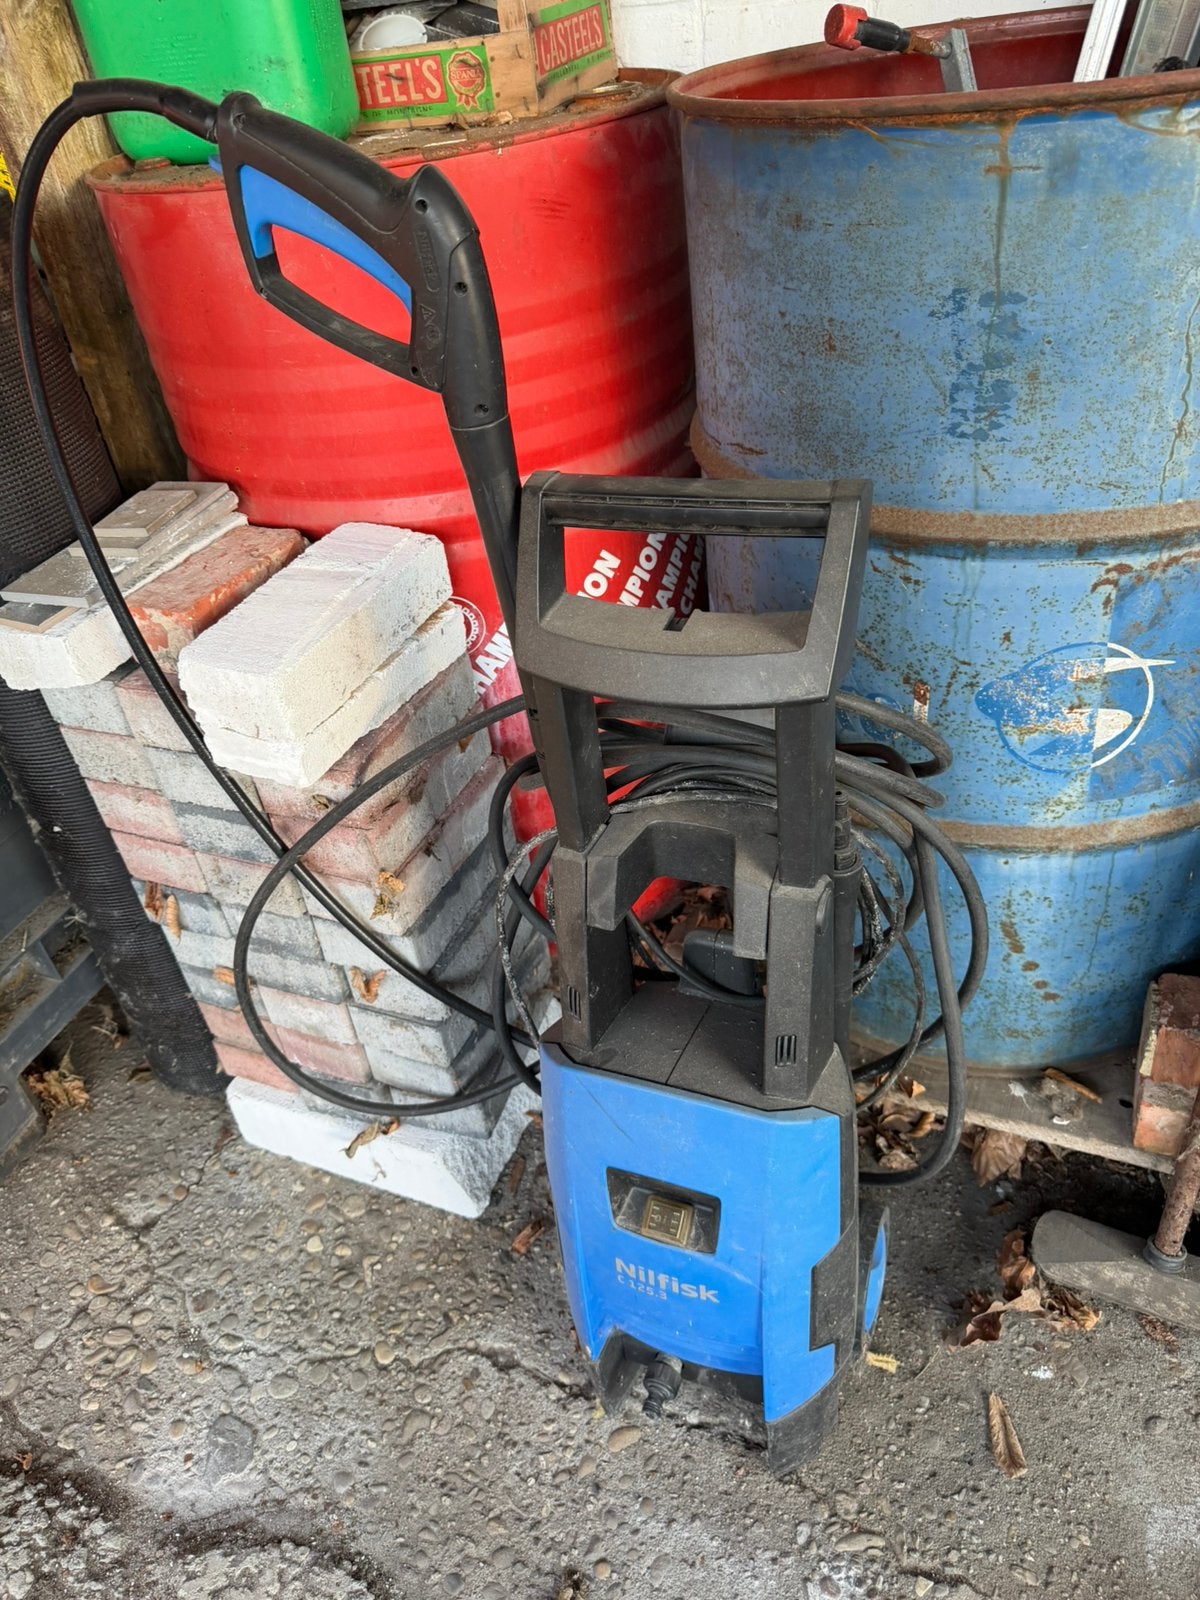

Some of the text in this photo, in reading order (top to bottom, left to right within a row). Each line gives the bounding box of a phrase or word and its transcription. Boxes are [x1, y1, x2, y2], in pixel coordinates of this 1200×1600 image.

[356, 58, 442, 105] TEEL'S
[473, 621, 513, 694] HAM
[615, 1257, 719, 1303] Nilfisk
